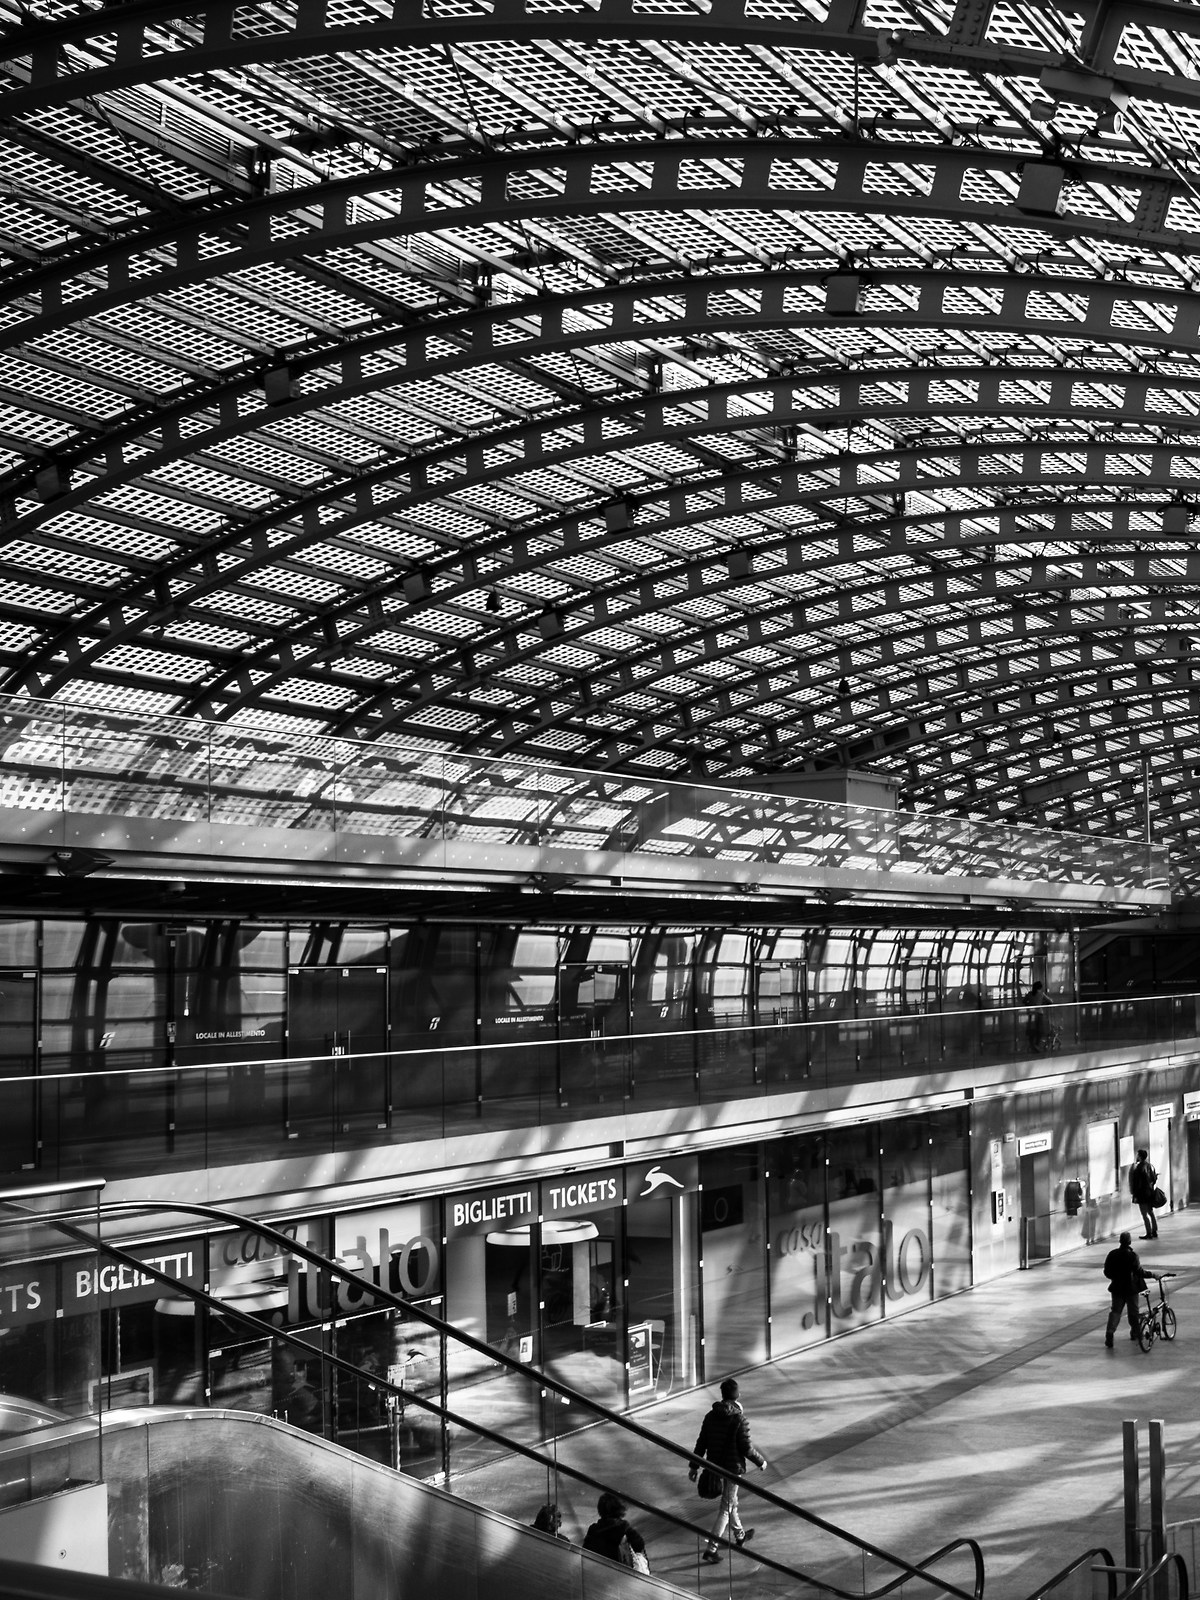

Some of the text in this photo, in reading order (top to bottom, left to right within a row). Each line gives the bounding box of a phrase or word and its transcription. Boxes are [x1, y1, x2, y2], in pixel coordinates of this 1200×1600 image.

[195, 1032, 217, 1040] LOCALE
[226, 1030, 266, 1038] ALLESTIMENTO
[453, 1178, 617, 1227] BIGLIETTI TICKETS
[0, 1251, 193, 1313] TS BIGLIETTI
